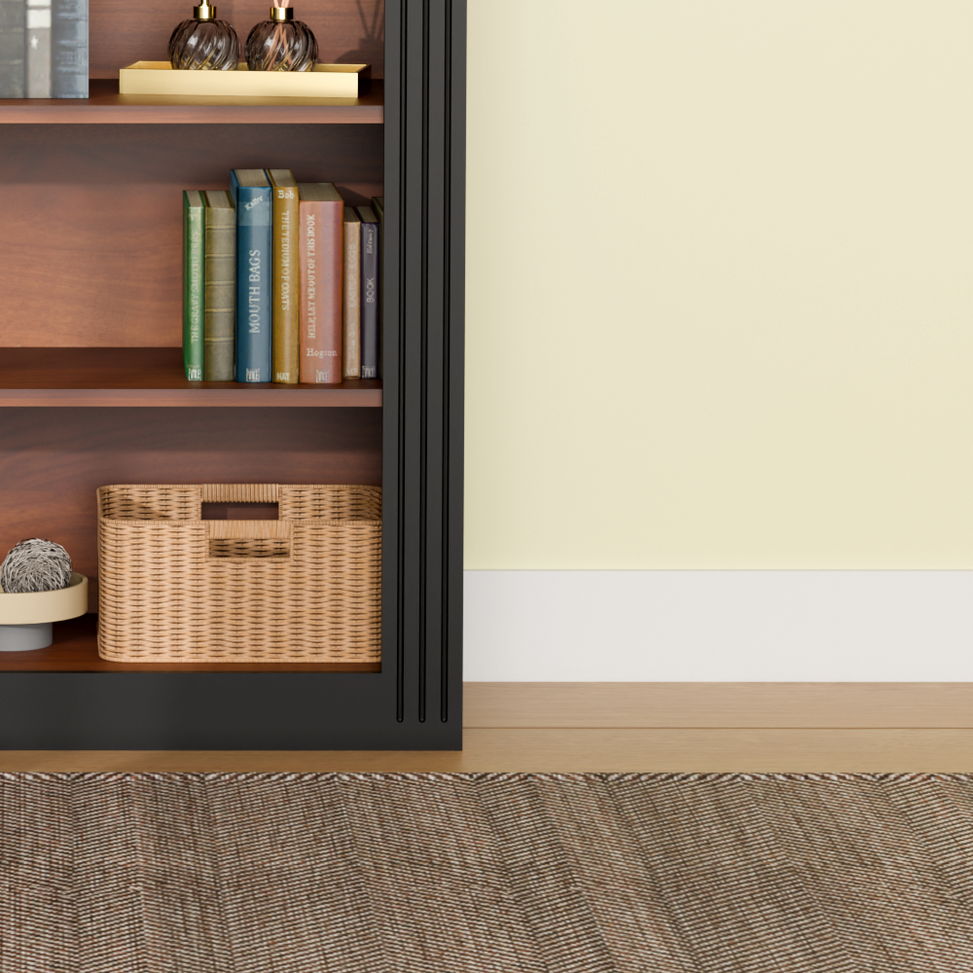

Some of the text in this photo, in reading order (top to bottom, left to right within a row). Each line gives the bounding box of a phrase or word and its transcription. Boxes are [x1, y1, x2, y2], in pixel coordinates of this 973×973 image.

[278, 190, 295, 199] Bob
[281, 210, 290, 230] THE
[249, 249, 261, 334] MOUTH BAGS
[348, 274, 356, 308] EASTER
[366, 278, 374, 303] BOOK
[307, 301, 316, 316] LET
